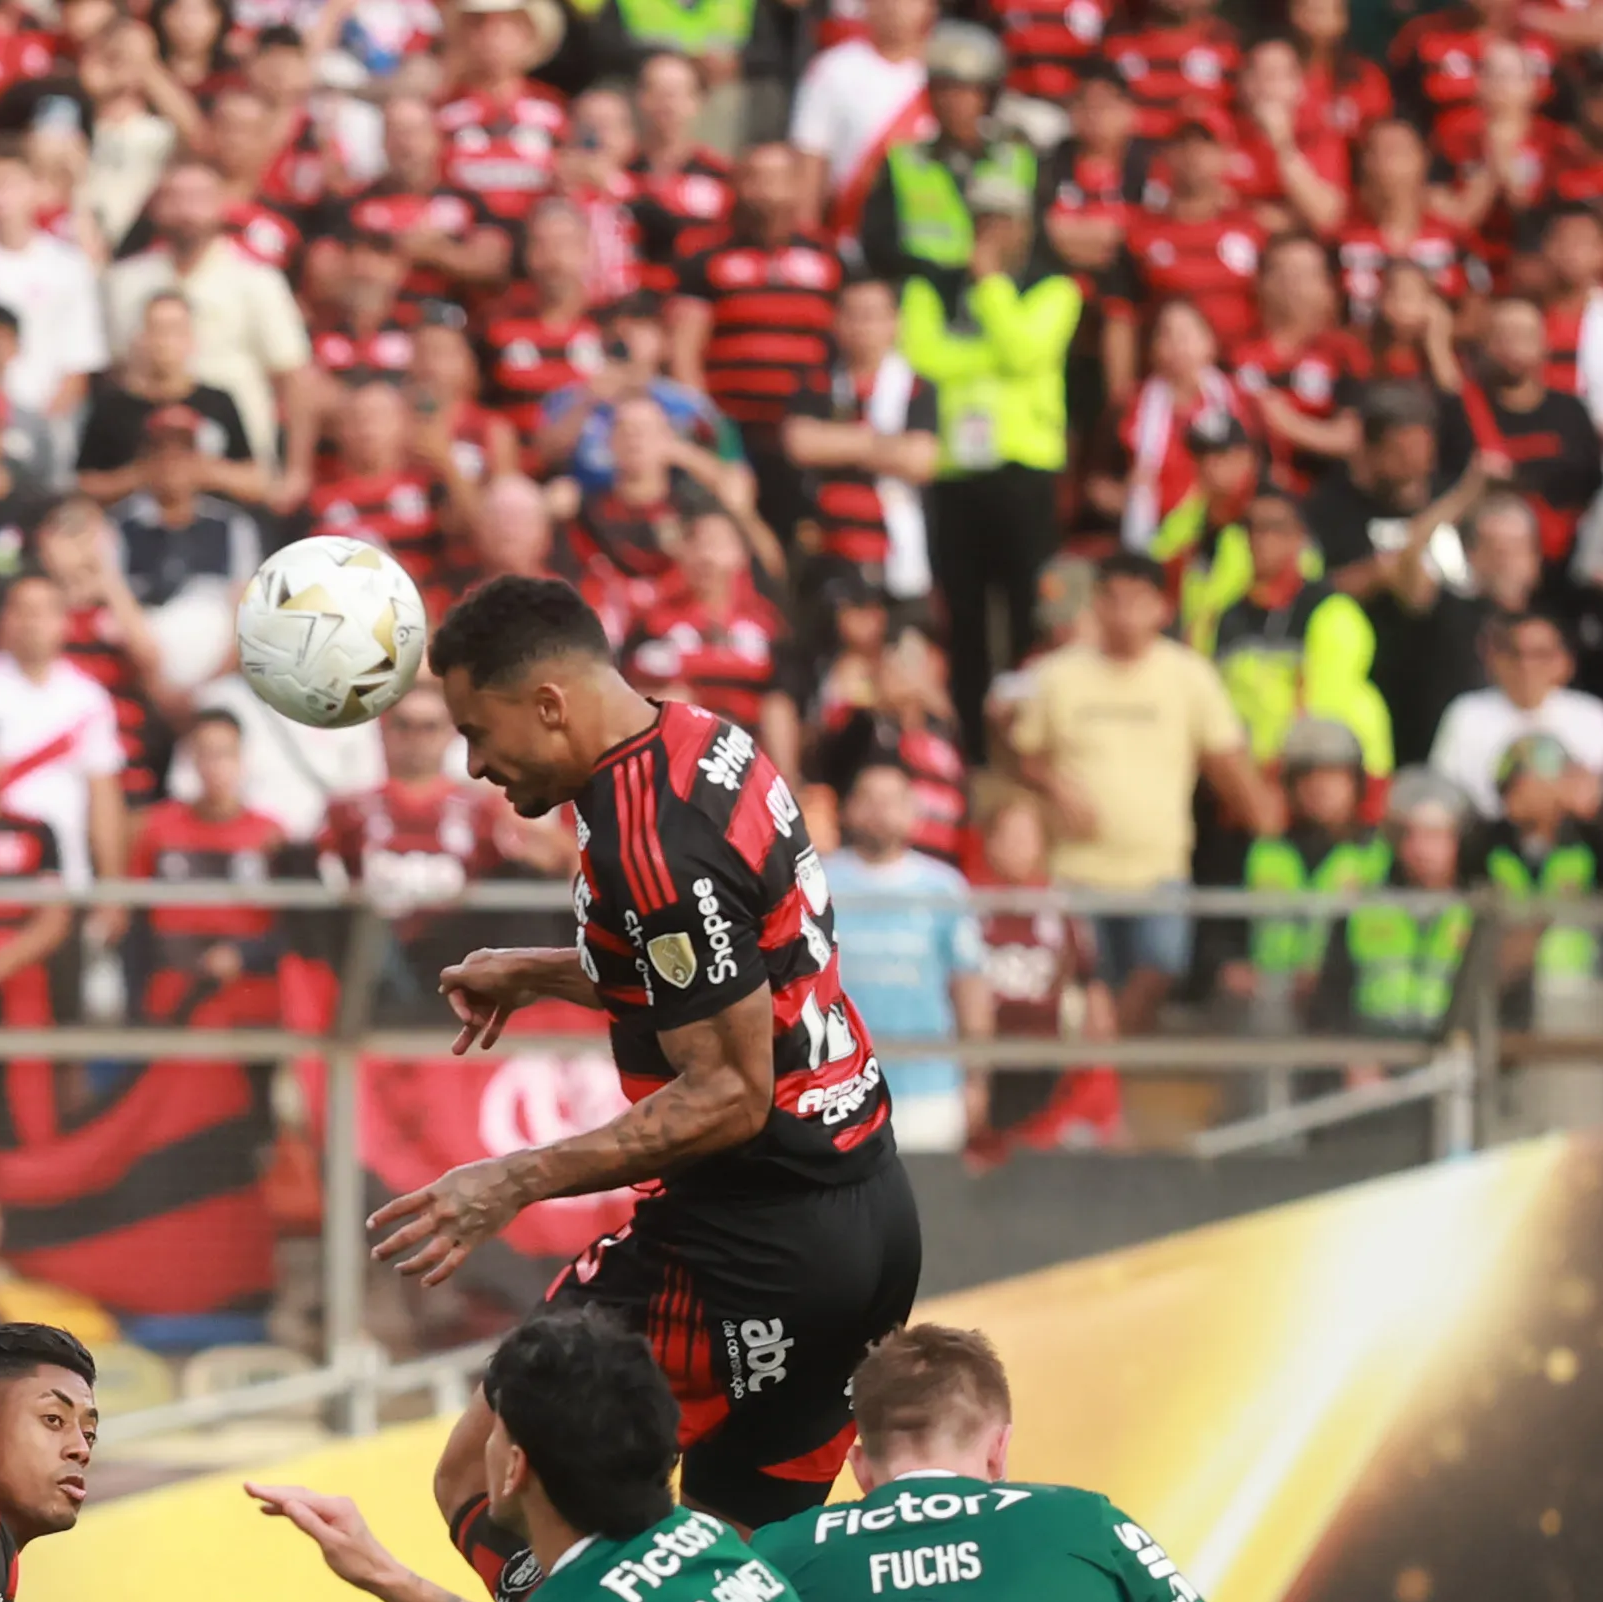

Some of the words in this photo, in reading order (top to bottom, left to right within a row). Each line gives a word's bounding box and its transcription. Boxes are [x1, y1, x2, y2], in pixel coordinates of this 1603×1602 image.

[740, 1317, 794, 1392] abc
[815, 1491, 987, 1544] Fictor
[869, 1541, 982, 1593] FUCHS
